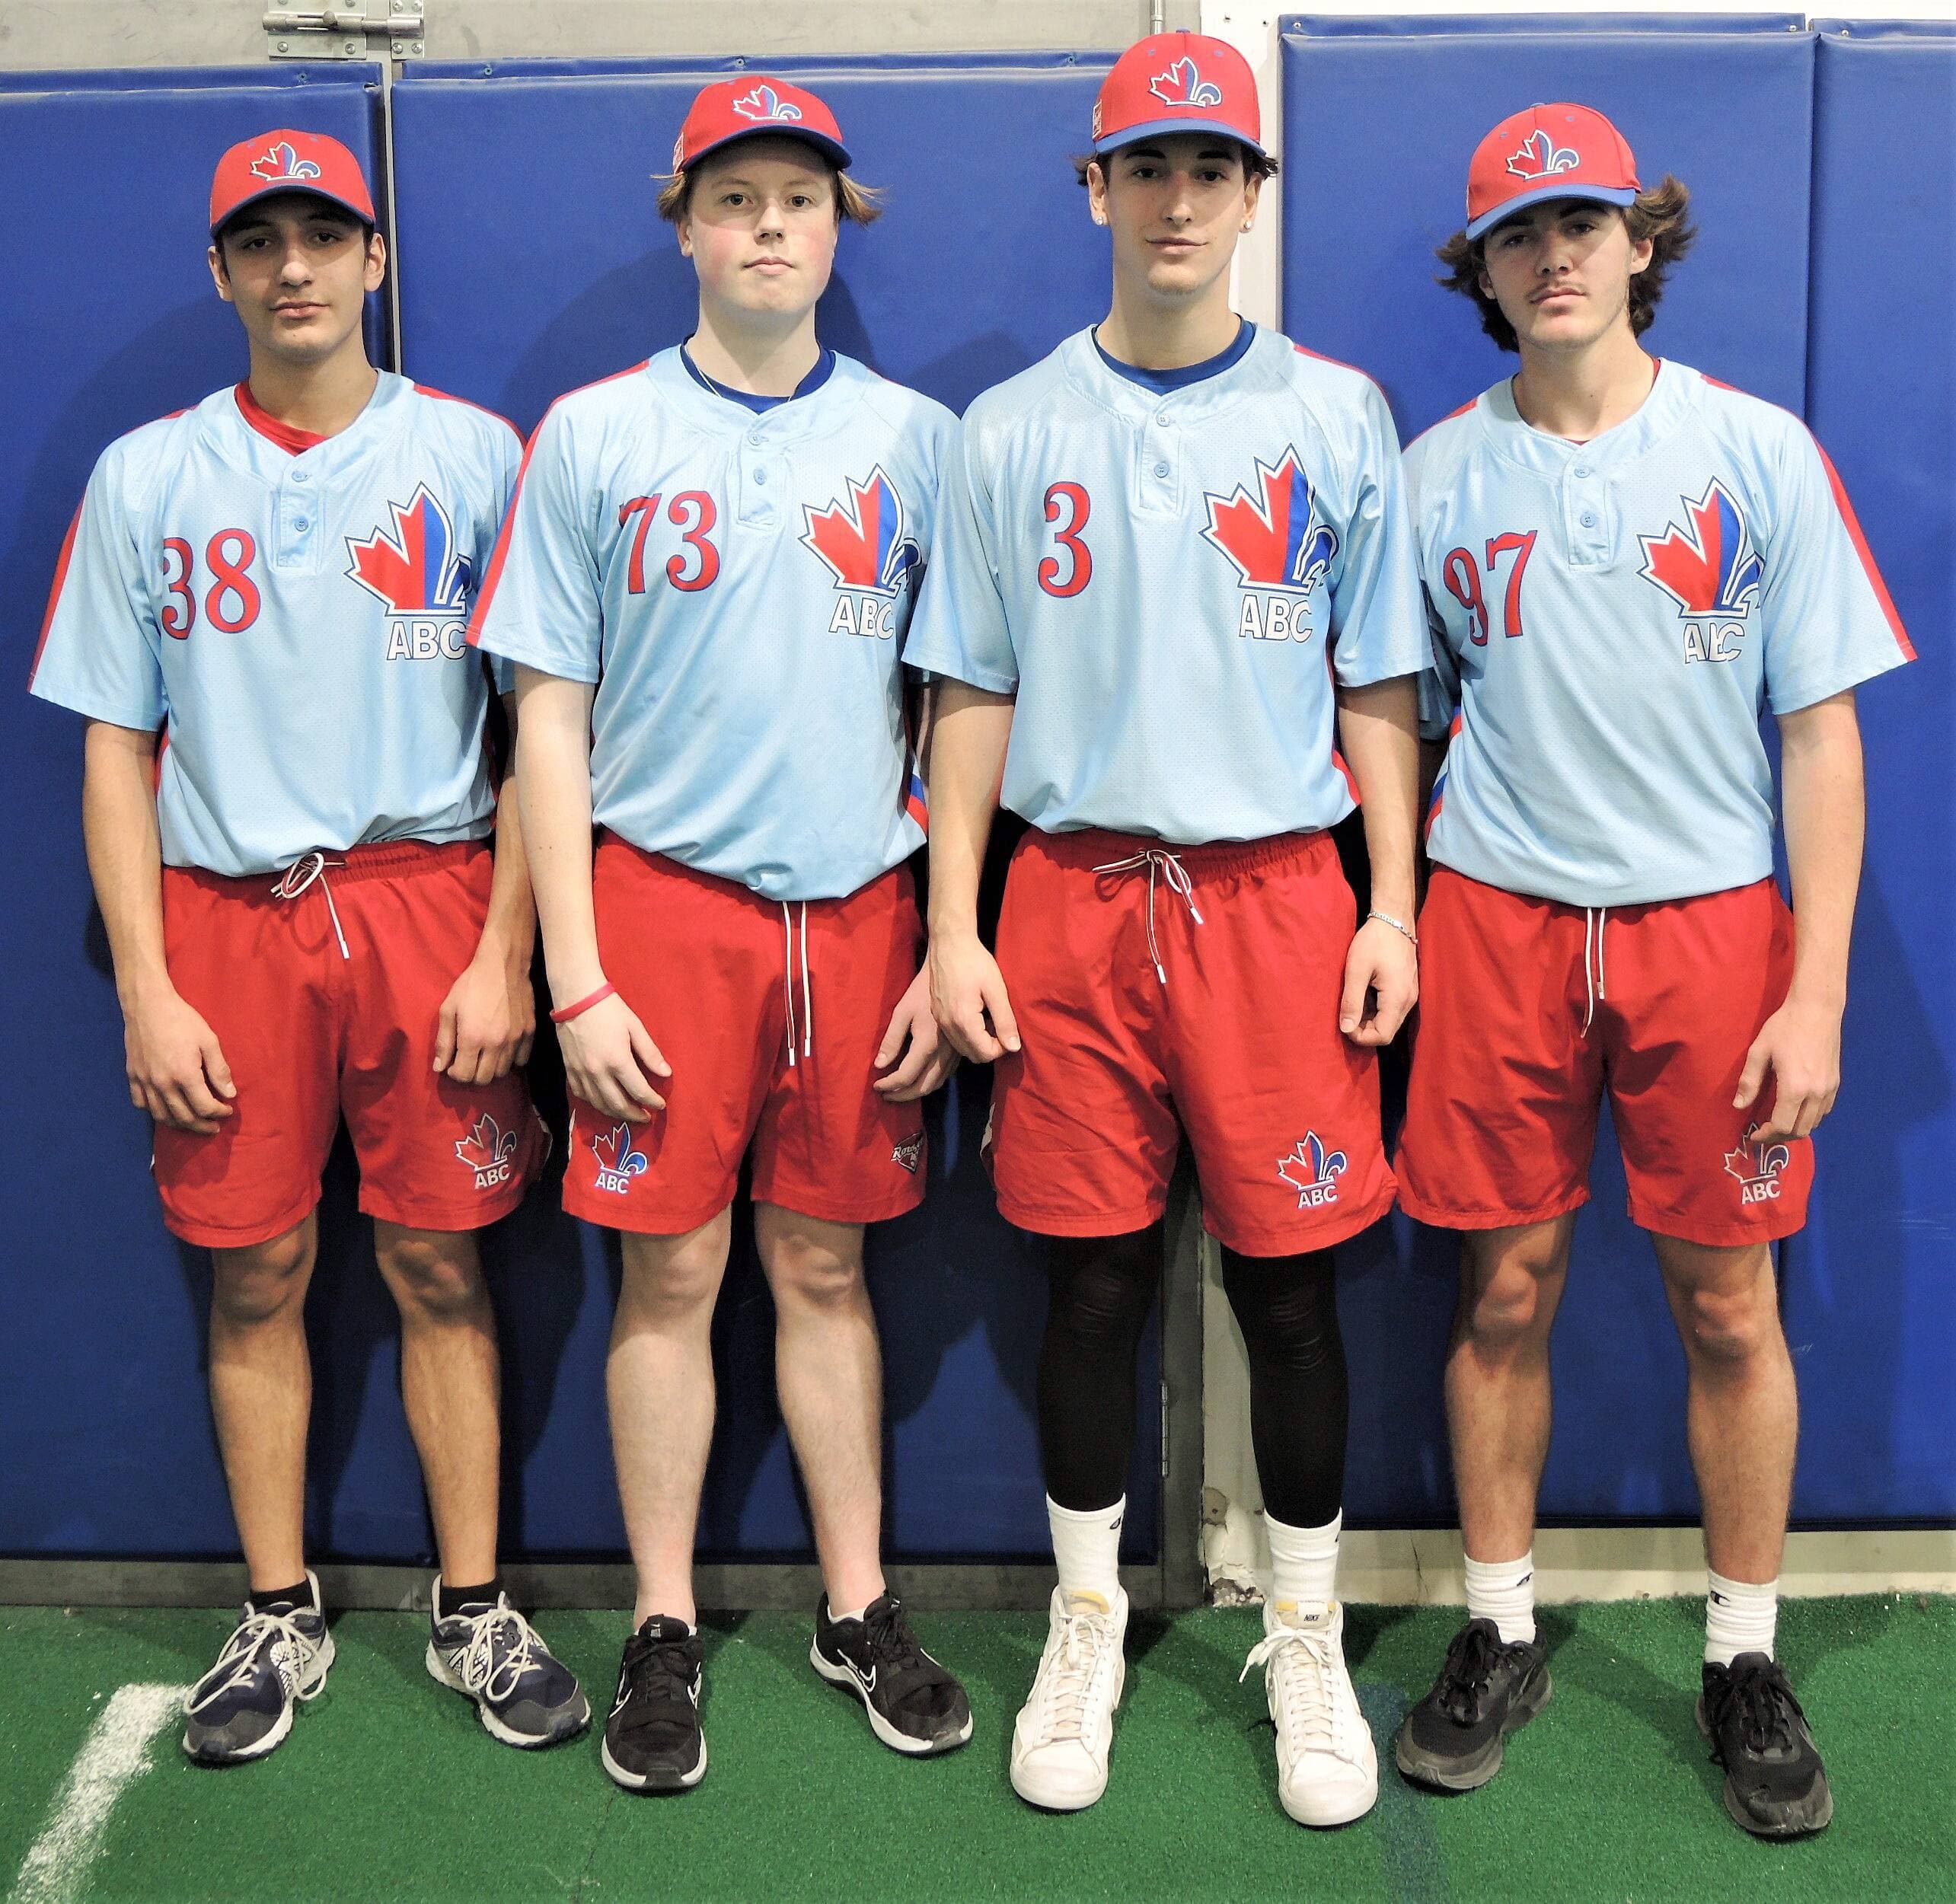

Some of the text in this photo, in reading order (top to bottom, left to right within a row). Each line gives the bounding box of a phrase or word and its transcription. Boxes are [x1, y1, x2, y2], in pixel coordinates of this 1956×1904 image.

[618, 490, 720, 595] 73
[1038, 481, 1093, 598] 3
[161, 528, 260, 639] 38
[1443, 530, 1538, 646] 97
[828, 595, 895, 639] ABC
[1239, 595, 1313, 643] ABC
[387, 621, 467, 660] ABC
[474, 1164, 510, 1190] ABC
[594, 1173, 629, 1194] ABC
[1297, 1185, 1339, 1209] ABC
[1741, 1180, 1781, 1205] ABC
